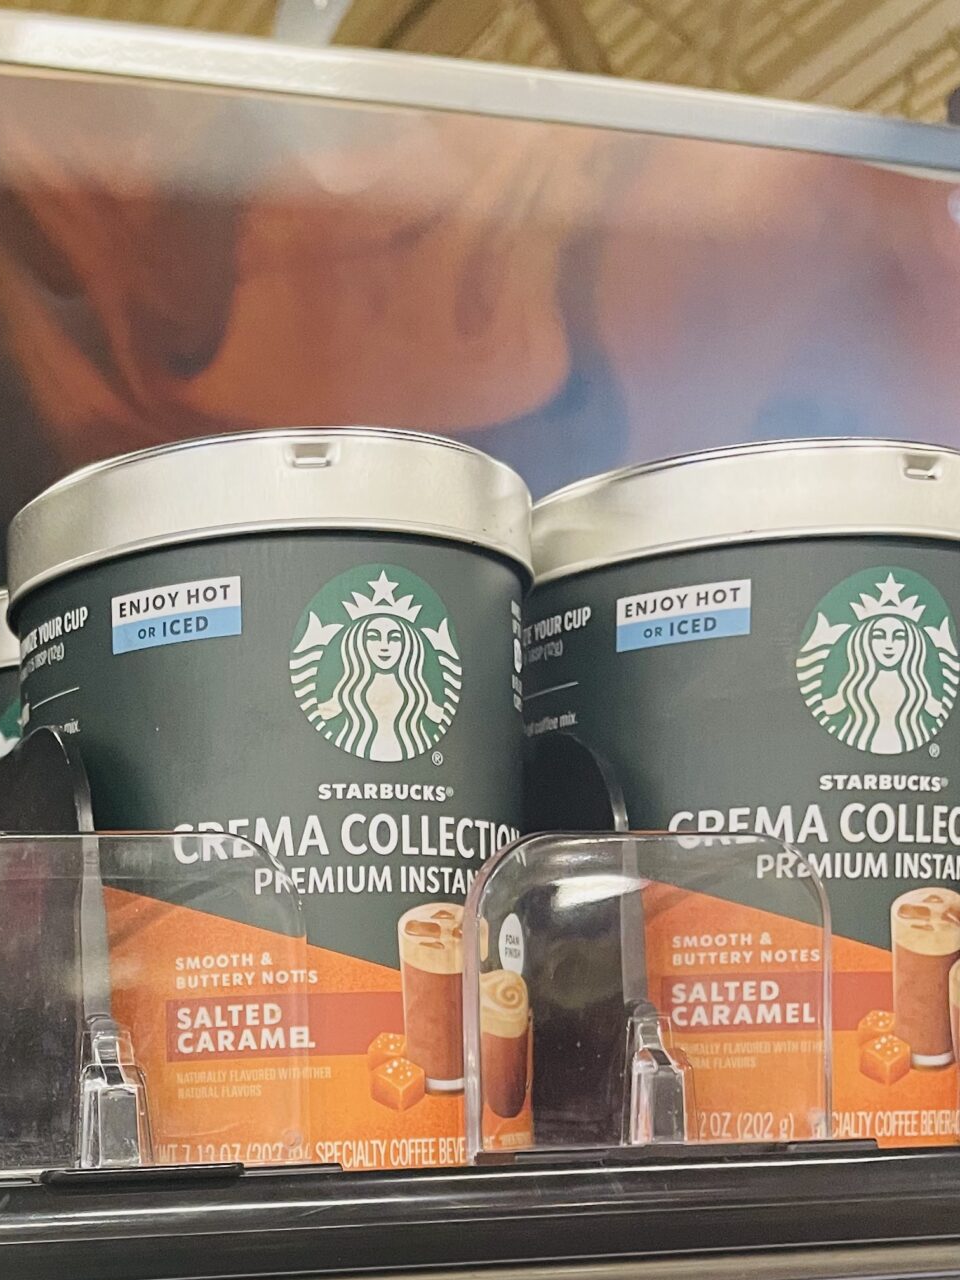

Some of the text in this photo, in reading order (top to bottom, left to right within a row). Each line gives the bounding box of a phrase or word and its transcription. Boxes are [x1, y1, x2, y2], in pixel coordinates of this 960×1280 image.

[119, 584, 231, 618] ENJOY HOT
[625, 587, 741, 619] ENJOY HOT
[38, 616, 62, 645] YOUR
[64, 606, 88, 633] CUP
[138, 616, 208, 640] OR ICED
[534, 615, 562, 640] YOUR
[564, 606, 591, 631] CUP
[643, 616, 717, 640] OR ICED
[172, 812, 526, 866] CREMA COLLECTION
[668, 803, 960, 850] CREMA COLLE
[255, 865, 478, 895] PREMIUM INSTAN
[756, 852, 960, 880] PREMIUM INSTA
[505, 934, 521, 945] FOAM
[672, 932, 772, 949] SMOOTH &
[175, 953, 273, 971] SMOOTH &
[672, 948, 821, 966] BUTTERY NOTES
[175, 971, 254, 989] BUTTERY
[671, 980, 780, 1004] SALTED
[176, 1003, 282, 1031] SALTED
[672, 1002, 816, 1027] CARAMEL
[176, 1026, 317, 1055] CARAMEL
[710, 1111, 773, 1139] OZ (202
[875, 1110, 918, 1137] COFFEE
[315, 1139, 387, 1168] SPECIALTY
[390, 1137, 436, 1166] COFFEE
